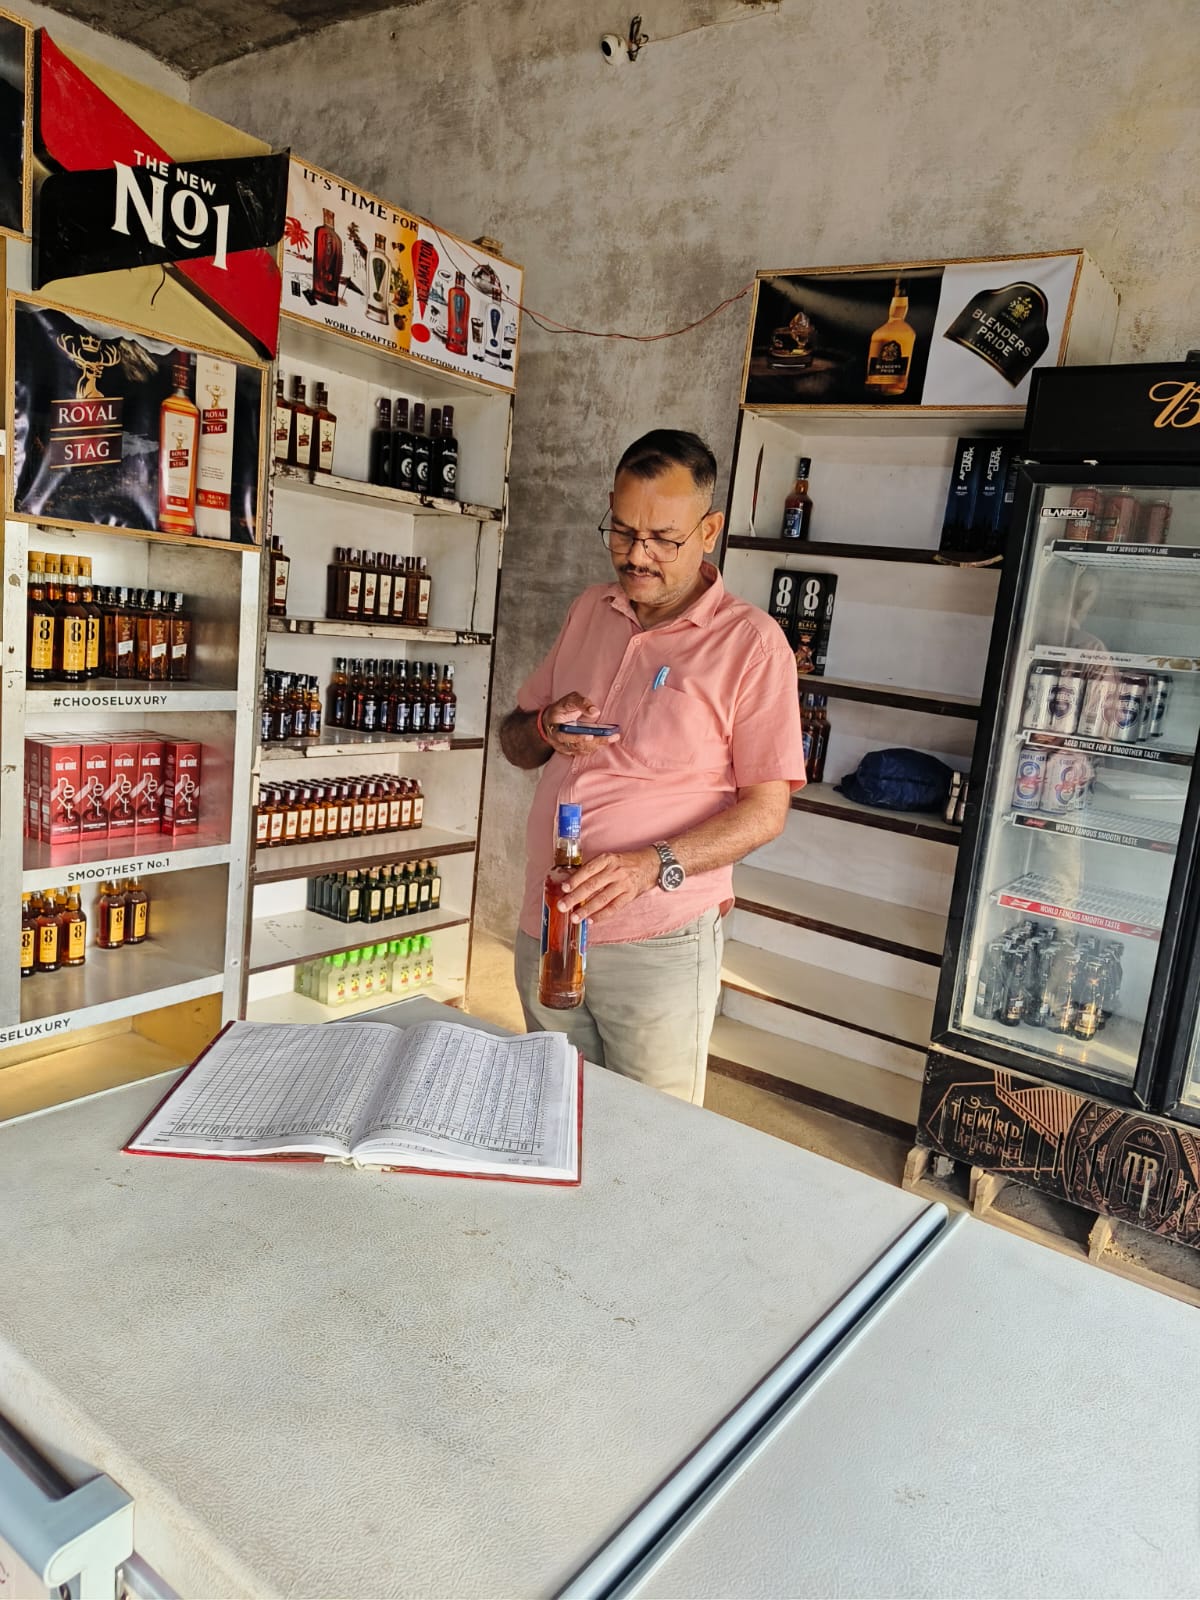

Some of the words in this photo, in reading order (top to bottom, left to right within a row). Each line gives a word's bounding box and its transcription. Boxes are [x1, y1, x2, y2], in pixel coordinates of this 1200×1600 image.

[134, 150, 169, 178] THE
[176, 168, 216, 196] NEW
[303, 168, 332, 191] IT'S
[337, 184, 388, 221] TIME
[392, 214, 419, 233] FOR
[972, 308, 1031, 357] BLENDERS
[976, 326, 1014, 358] PRIDE
[324, 317, 398, 349] WORLD-CRAFTED
[411, 351, 461, 373] EXCEPTIONAL
[462, 368, 484, 379] TASTE
[58, 404, 117, 424] ROYAL
[204, 411, 226, 419] ROYAL
[206, 424, 224, 433] STAG
[64, 441, 110, 461] STAG
[1042, 508, 1087, 517] ELANPRO
[775, 577, 793, 607] 8
[803, 579, 821, 611] 8
[776, 606, 788, 614] PM
[803, 609, 816, 617] PM
[826, 593, 834, 616] 8
[40, 619, 51, 641] 8
[71, 621, 81, 642] 8
[53, 695, 167, 707] #CHOOSELUXURY
[1079, 740, 1095, 750] TWICE
[1112, 745, 1143, 757] SMOOTHER
[1143, 749, 1160, 759] TASTE
[1055, 823, 1075, 833] WORLD
[1098, 830, 1121, 842] SMOOTH
[1121, 835, 1138, 845] TASTE
[68, 862, 144, 882] SMOOTHEST
[146, 858, 170, 869] No.1
[115, 910, 123, 923] 8
[140, 905, 146, 918] 8
[1040, 905, 1058, 916] WORLD
[1059, 909, 1081, 921] FAMOUS
[1081, 914, 1104, 925] SMOOTH
[1104, 919, 1121, 930] TASTE
[22, 933, 31, 947] 8
[45, 929, 53, 943] 8
[74, 925, 82, 938] 8
[1181, 1133, 1198, 1165] EUROPE
